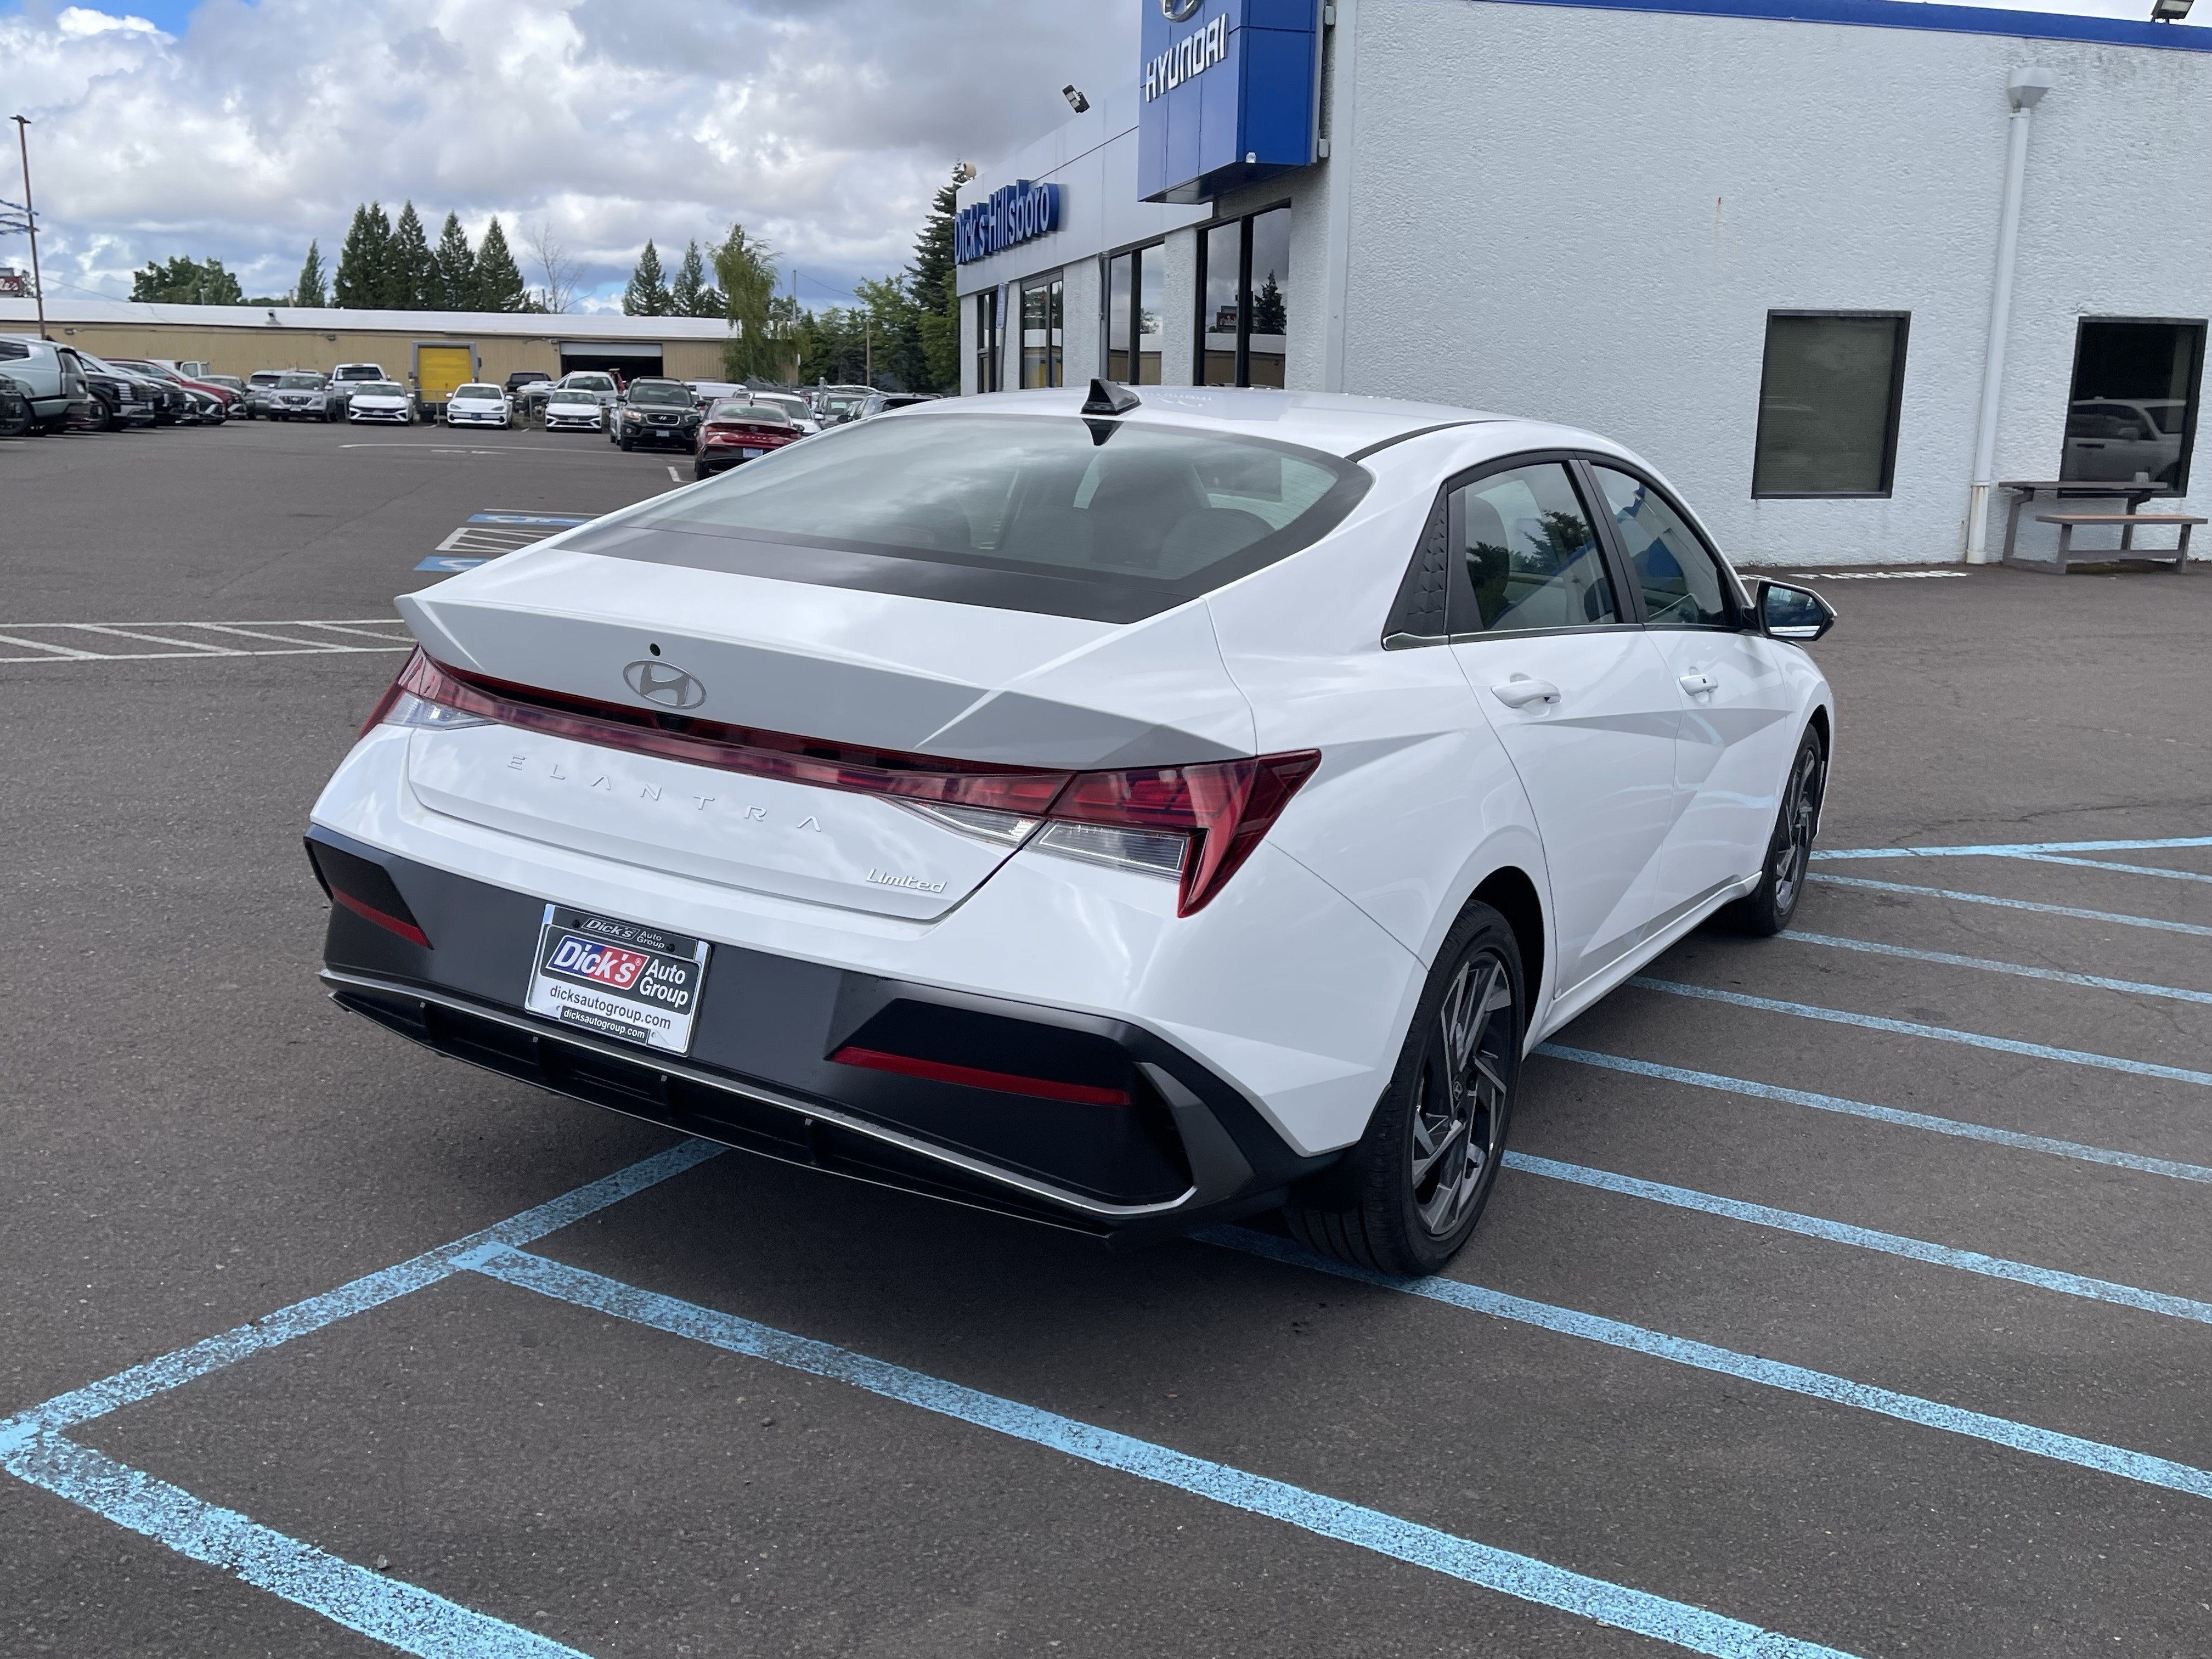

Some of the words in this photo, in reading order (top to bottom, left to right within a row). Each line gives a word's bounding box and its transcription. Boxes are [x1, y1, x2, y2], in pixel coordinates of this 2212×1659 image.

[1146, 13, 1228, 103] HYUNDAI
[955, 202, 986, 266] Dick's
[989, 180, 1049, 252] Hillsboro
[507, 754, 822, 832] ELANTRA
[866, 868, 947, 893] Limited
[586, 919, 634, 938] Dick's
[636, 936, 665, 949] Group
[640, 931, 662, 941] Auto
[554, 940, 635, 983] Dick's
[645, 959, 686, 984] Auto
[550, 986, 671, 1029] dicksautogroup.com
[640, 977, 689, 1008] Group
[563, 1008, 645, 1039] dicksautogroup.com
